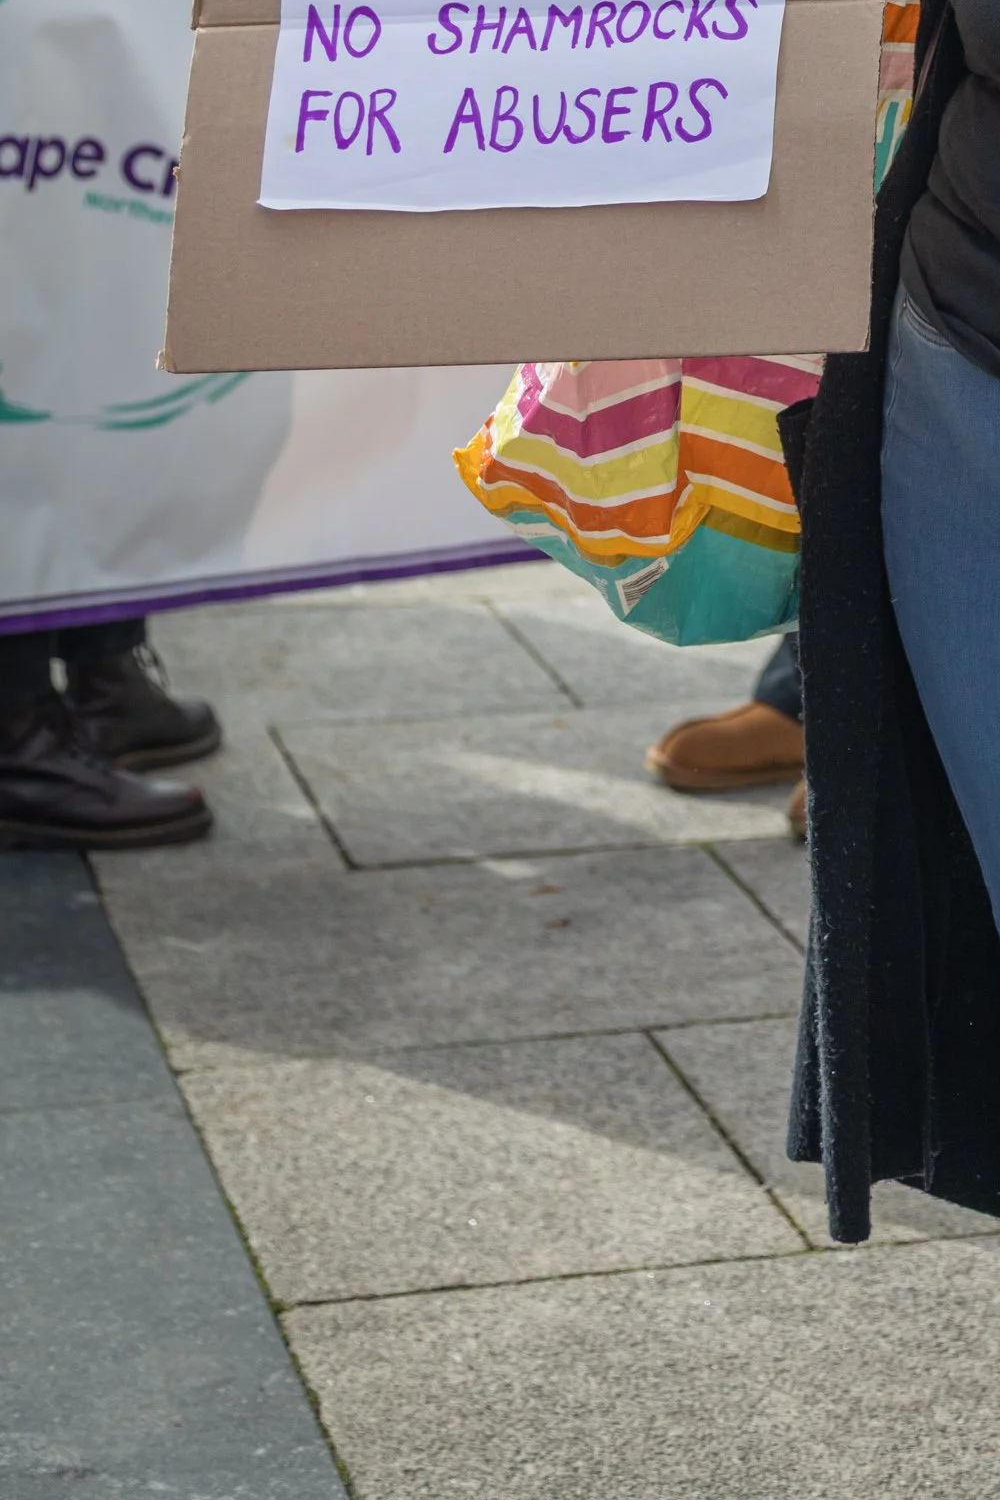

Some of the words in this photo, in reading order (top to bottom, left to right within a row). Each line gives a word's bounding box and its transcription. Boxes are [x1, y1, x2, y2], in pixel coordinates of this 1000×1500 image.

[302, 4, 382, 63] NO
[295, 88, 401, 156] FOR
[443, 77, 730, 154] ABUSERS
